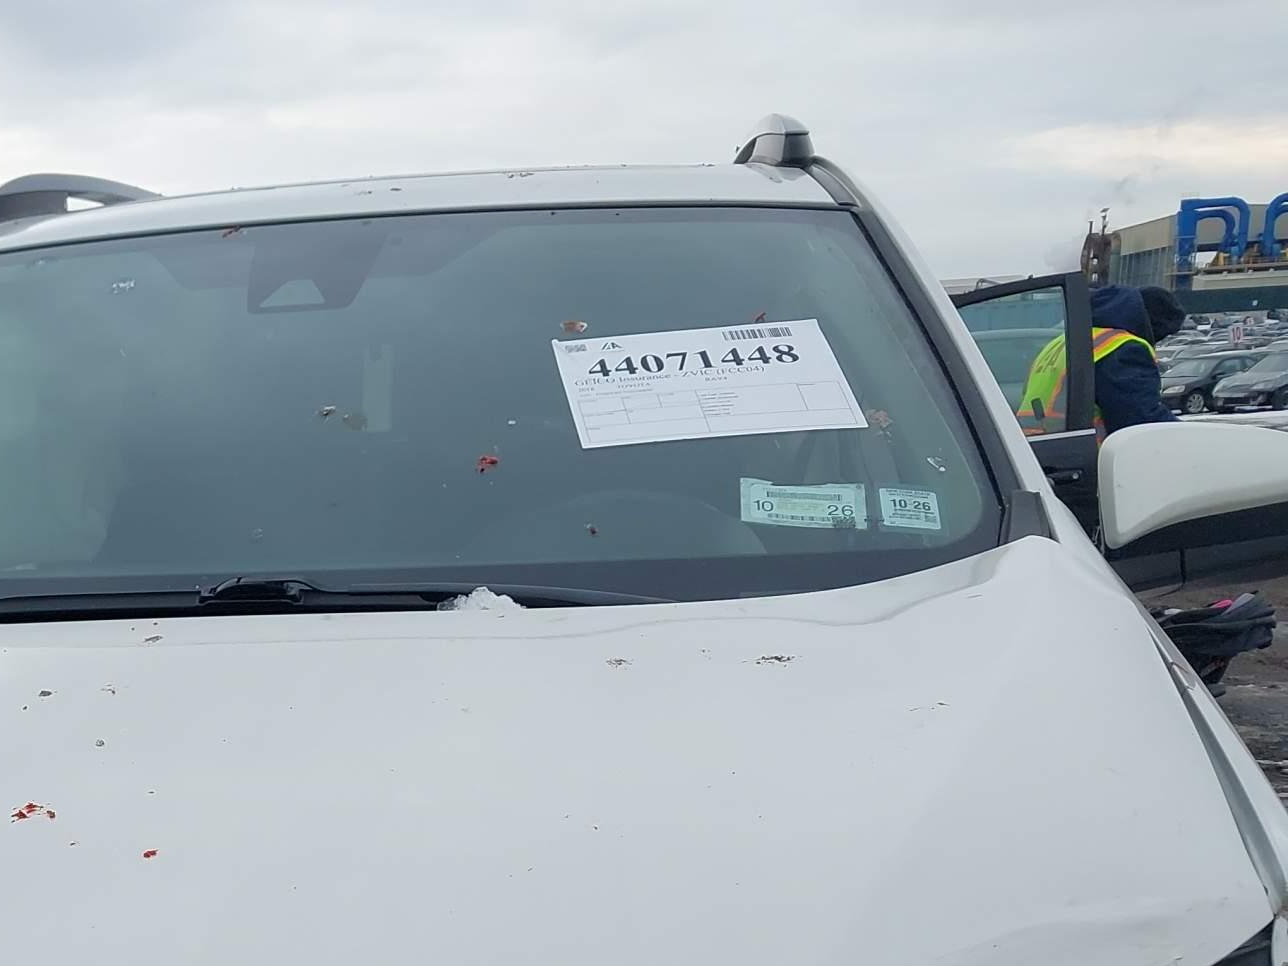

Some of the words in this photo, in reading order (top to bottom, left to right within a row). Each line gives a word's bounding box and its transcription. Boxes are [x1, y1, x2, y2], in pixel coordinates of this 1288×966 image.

[588, 344, 800, 377] 44071448
[619, 374, 671, 383] Insurance
[754, 499, 774, 512] 10
[827, 504, 854, 517] 26
